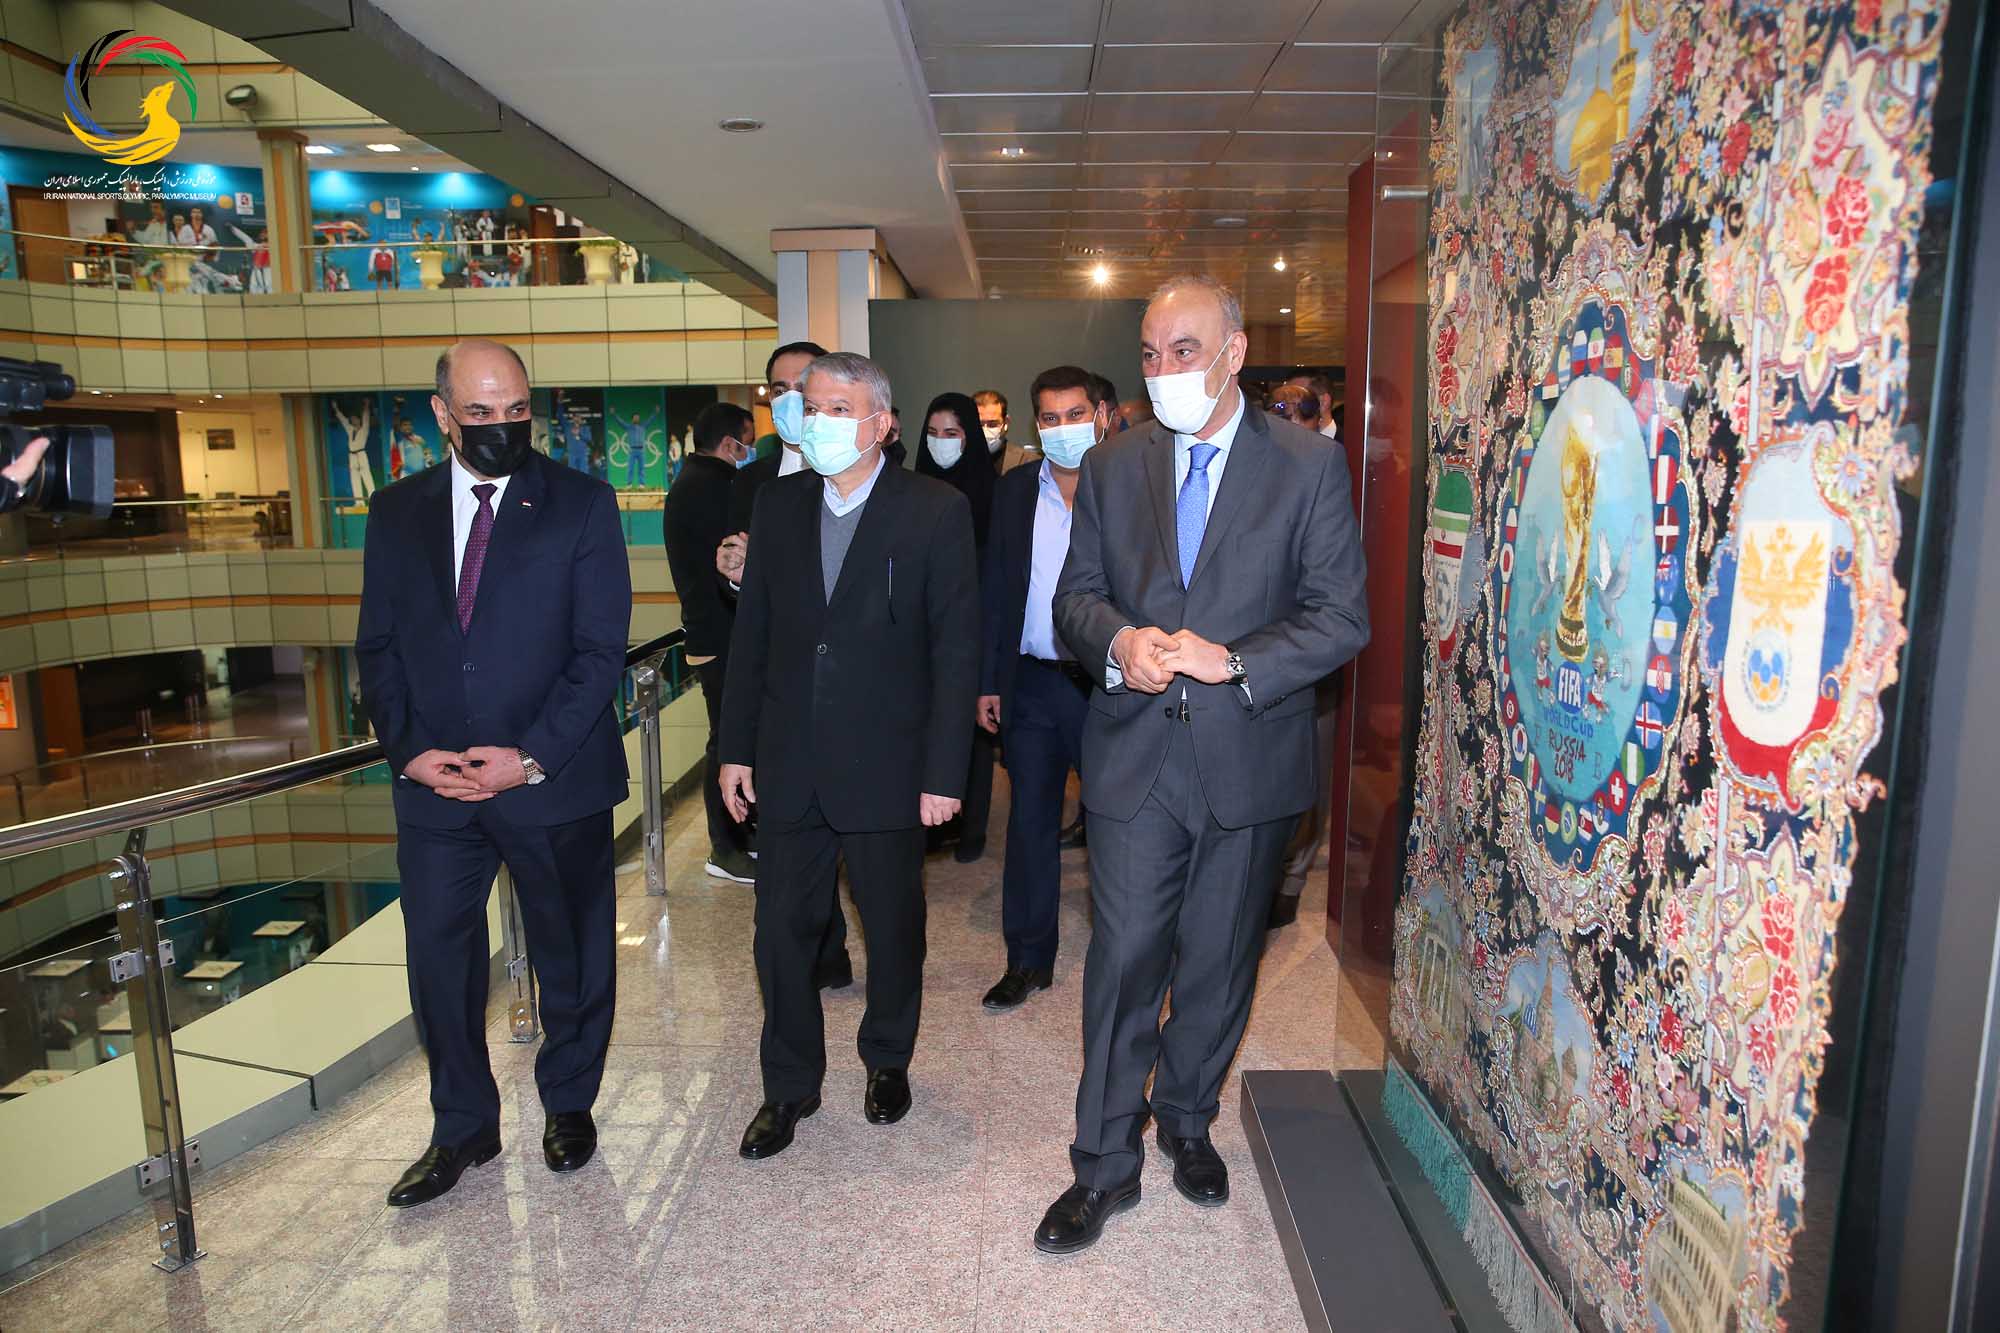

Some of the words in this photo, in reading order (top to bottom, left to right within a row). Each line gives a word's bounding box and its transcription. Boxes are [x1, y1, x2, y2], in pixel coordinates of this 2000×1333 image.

[1558, 666, 1582, 708] FIFA
[1543, 705, 1570, 728] WORLD
[1548, 727, 1587, 762] RUSSIA
[1554, 752, 1574, 784] 2018
